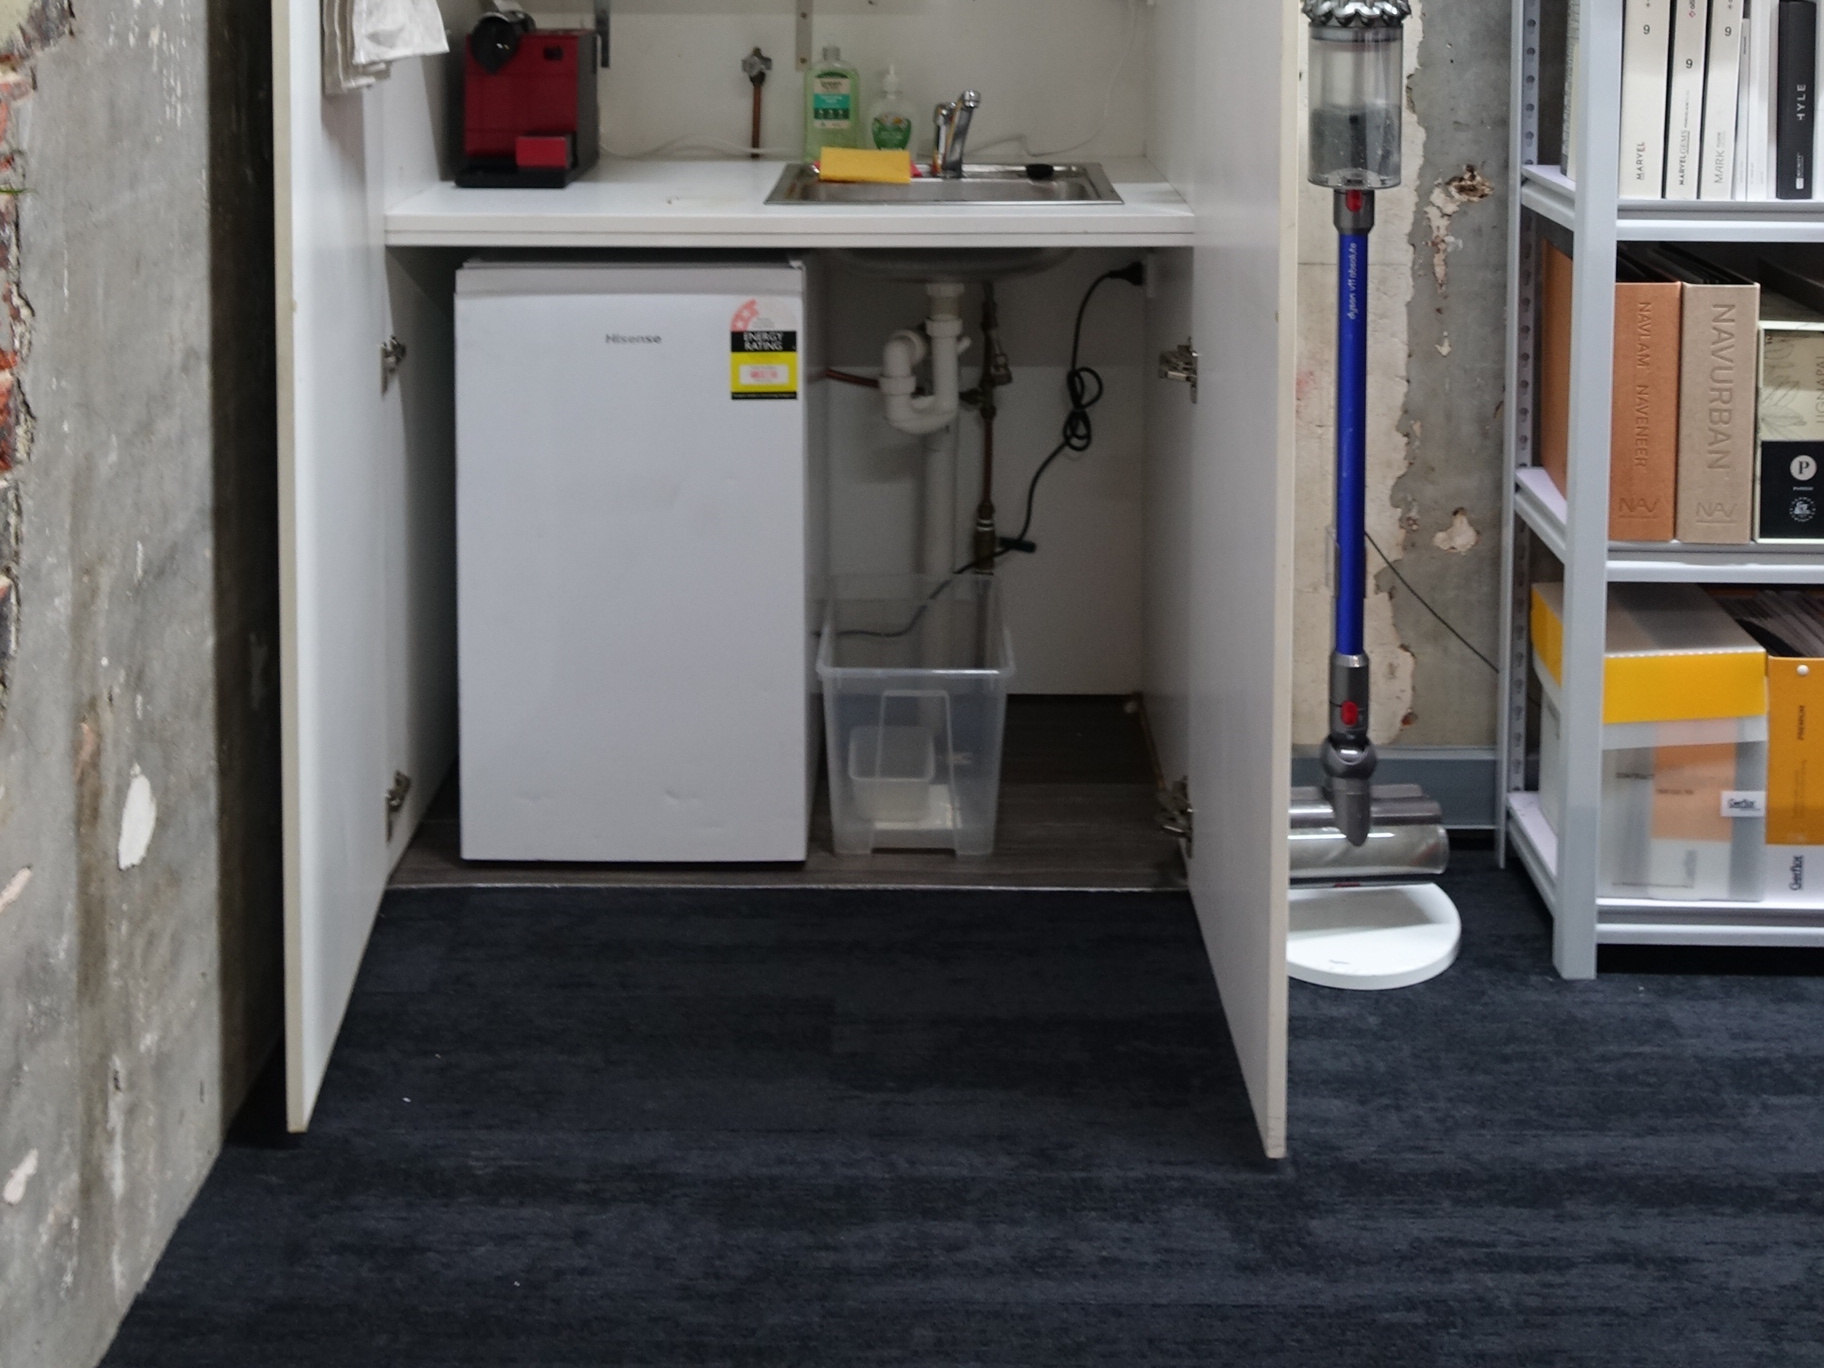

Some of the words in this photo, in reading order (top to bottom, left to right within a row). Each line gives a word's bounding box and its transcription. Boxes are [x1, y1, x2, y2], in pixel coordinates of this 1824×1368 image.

[1636, 142, 1645, 180] MARVEL
[1714, 151, 1725, 183] MARK
[1348, 242, 1357, 278] absolute
[1347, 293, 1358, 320] dyson
[605, 334, 662, 344] Hisense
[743, 331, 782, 341] ENERGY
[744, 341, 783, 351] RATING
[1637, 301, 1652, 369] NAVLAM
[1707, 304, 1736, 469] NAVURBAN
[1634, 384, 1649, 467] NAVENEER
[1798, 460, 1810, 475] P
[1789, 855, 1803, 891] Gerflor
